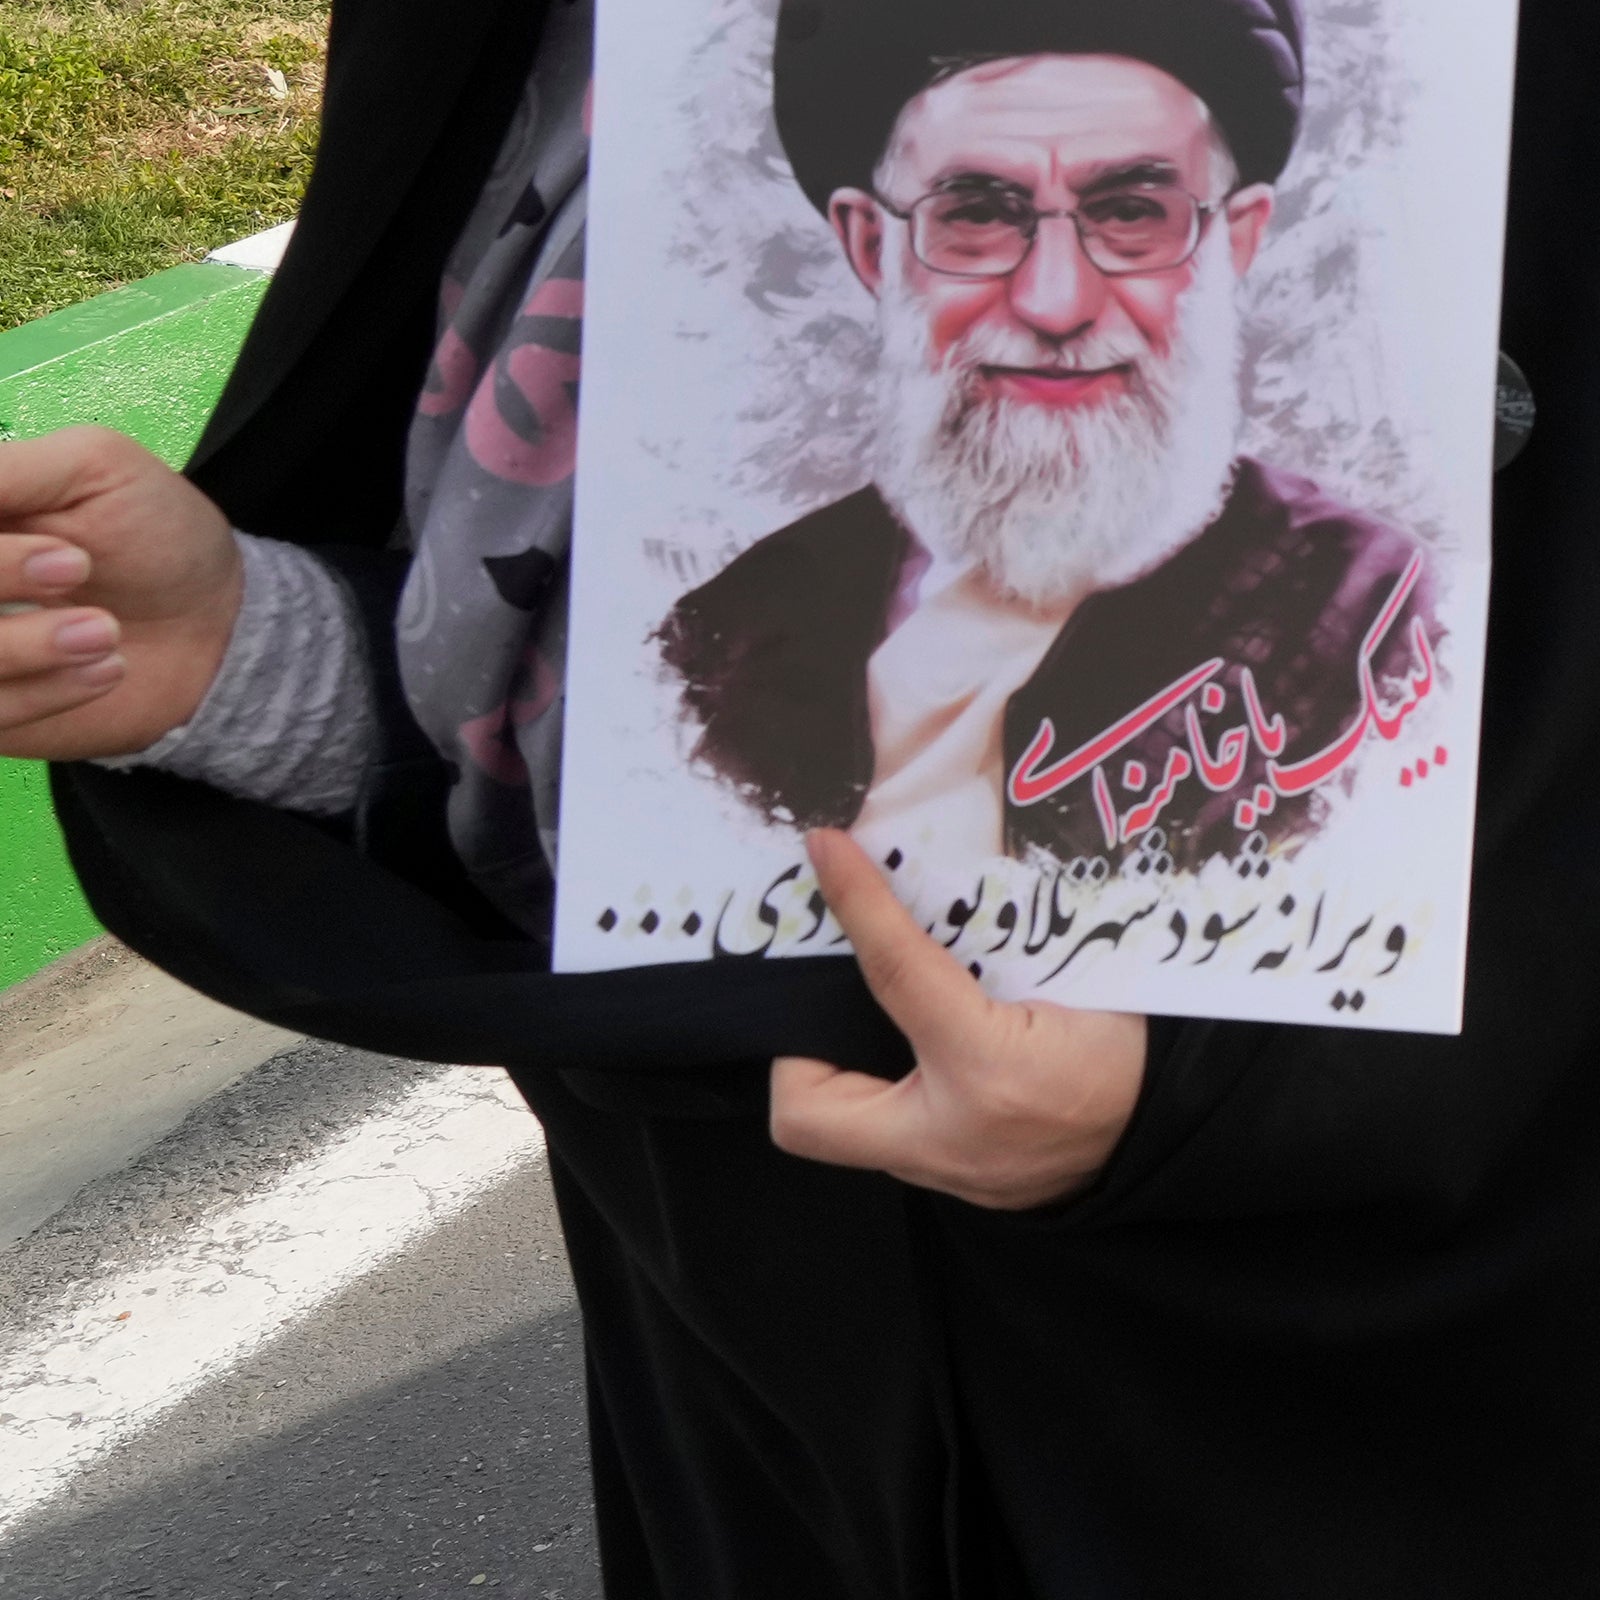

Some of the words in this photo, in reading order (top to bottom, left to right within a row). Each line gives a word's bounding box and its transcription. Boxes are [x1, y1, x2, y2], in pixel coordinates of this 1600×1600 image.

[1267, 546, 1449, 798] لبیک
[1034, 827, 1176, 989] شهر
[1157, 829, 1272, 967] شود
[1250, 889, 1409, 1012] ویرانه
